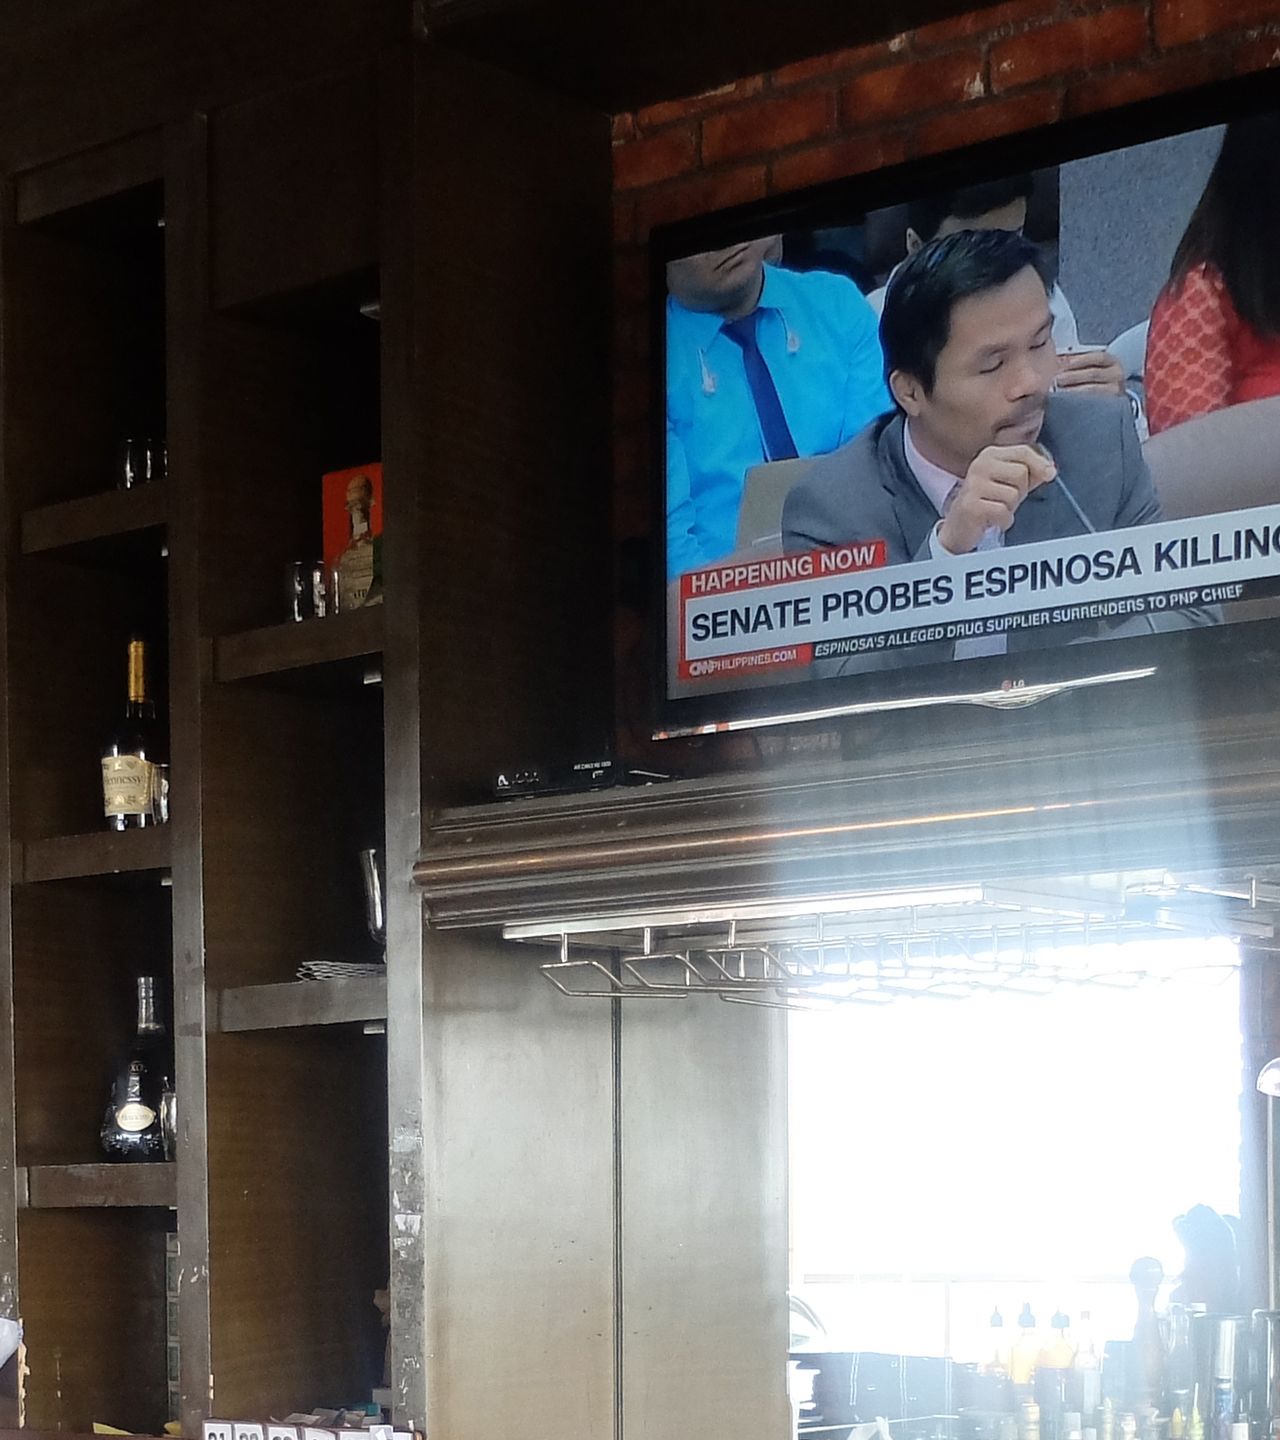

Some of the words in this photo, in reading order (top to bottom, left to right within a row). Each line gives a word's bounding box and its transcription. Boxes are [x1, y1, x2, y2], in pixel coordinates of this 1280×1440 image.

[691, 555, 813, 593] HAPPENING
[821, 546, 876, 572] NOW
[691, 597, 811, 641] SENATE
[822, 575, 953, 622] PROBES
[964, 546, 1142, 601] ESPINOSA
[815, 634, 885, 657] ESPINOSA'S
[887, 627, 944, 649] ALLEGED
[946, 620, 984, 639] DRUG
[986, 611, 1050, 634] SUPPLIER
[1052, 598, 1145, 621] SURRENDERS
[1148, 595, 1166, 611] TO
[1170, 590, 1199, 607] PNP
[1201, 584, 1244, 602] CHIEF
